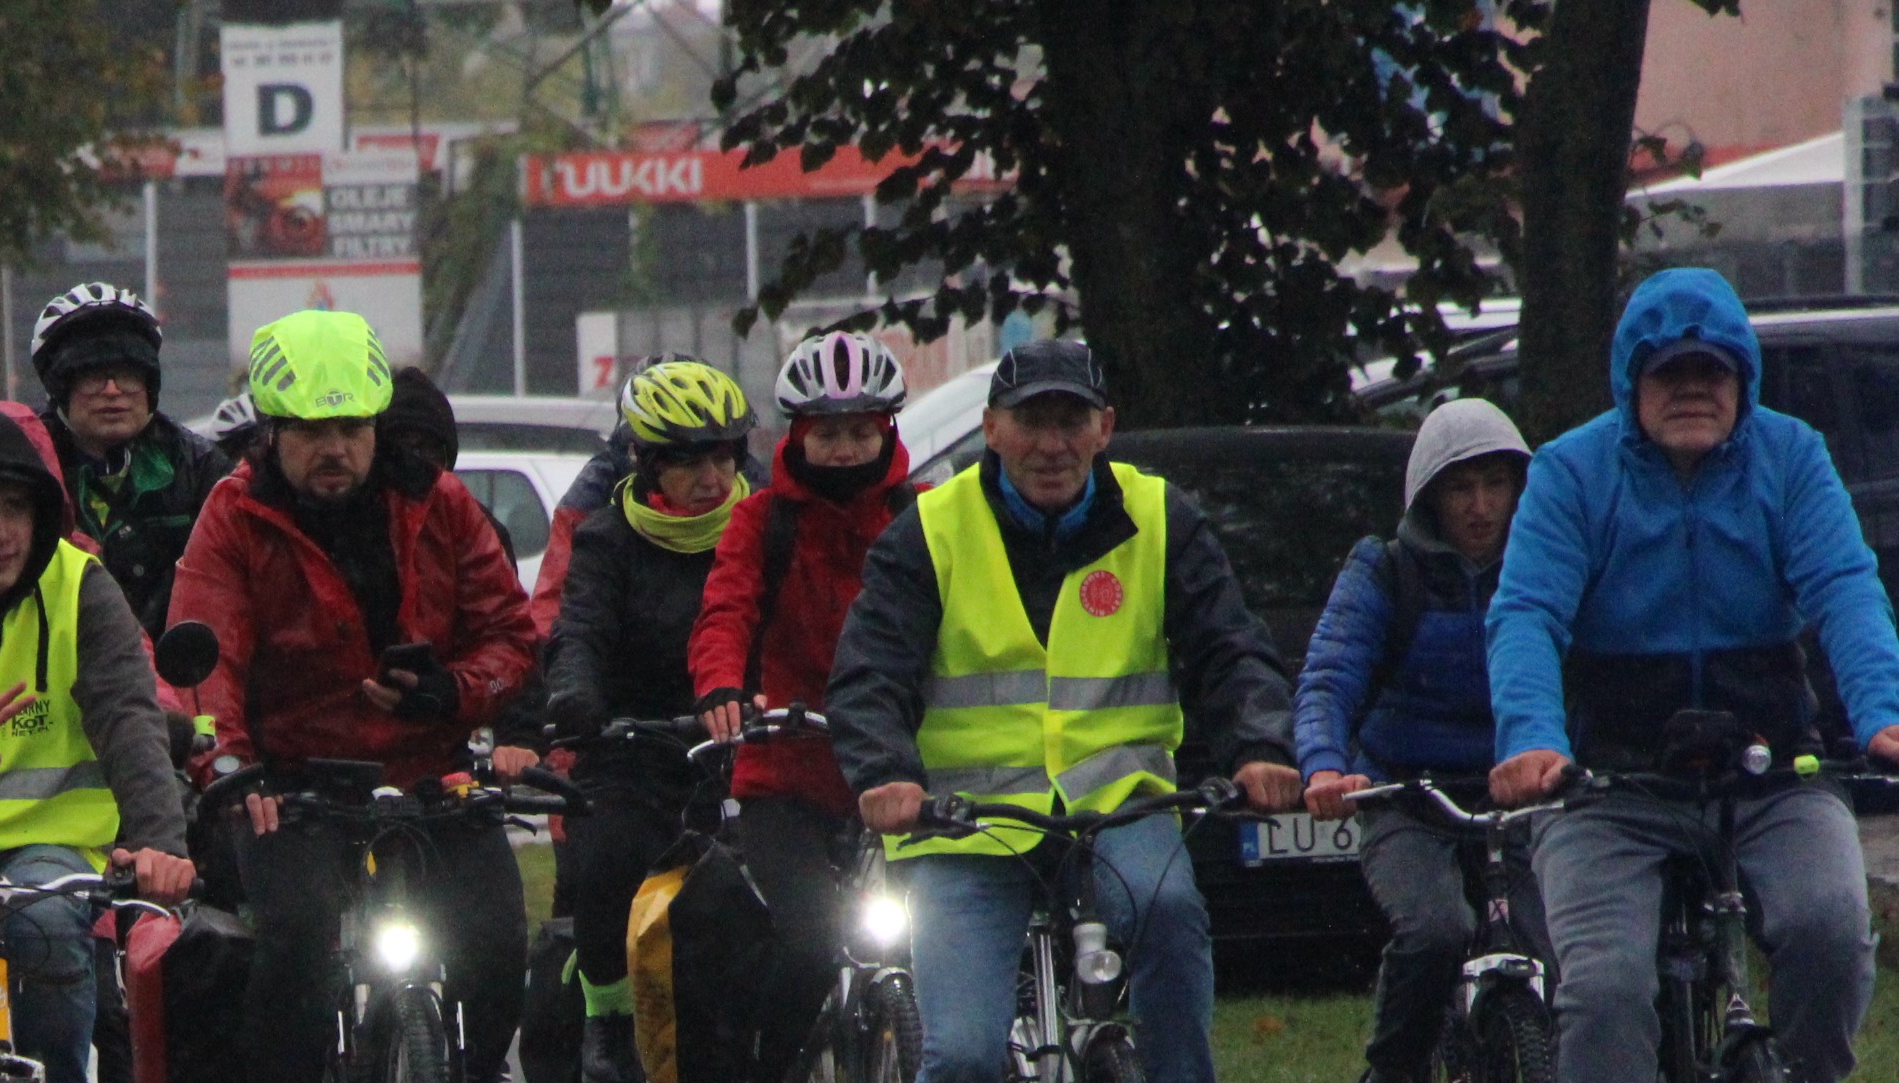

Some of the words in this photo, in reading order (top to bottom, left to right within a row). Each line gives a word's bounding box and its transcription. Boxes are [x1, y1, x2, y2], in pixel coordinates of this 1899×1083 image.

[258, 83, 313, 135] D
[330, 187, 408, 208] OLEJE
[329, 211, 416, 233] SMARY
[332, 235, 413, 258] FILTRY
[315, 390, 355, 408] BTR
[1268, 816, 1315, 854] LU
